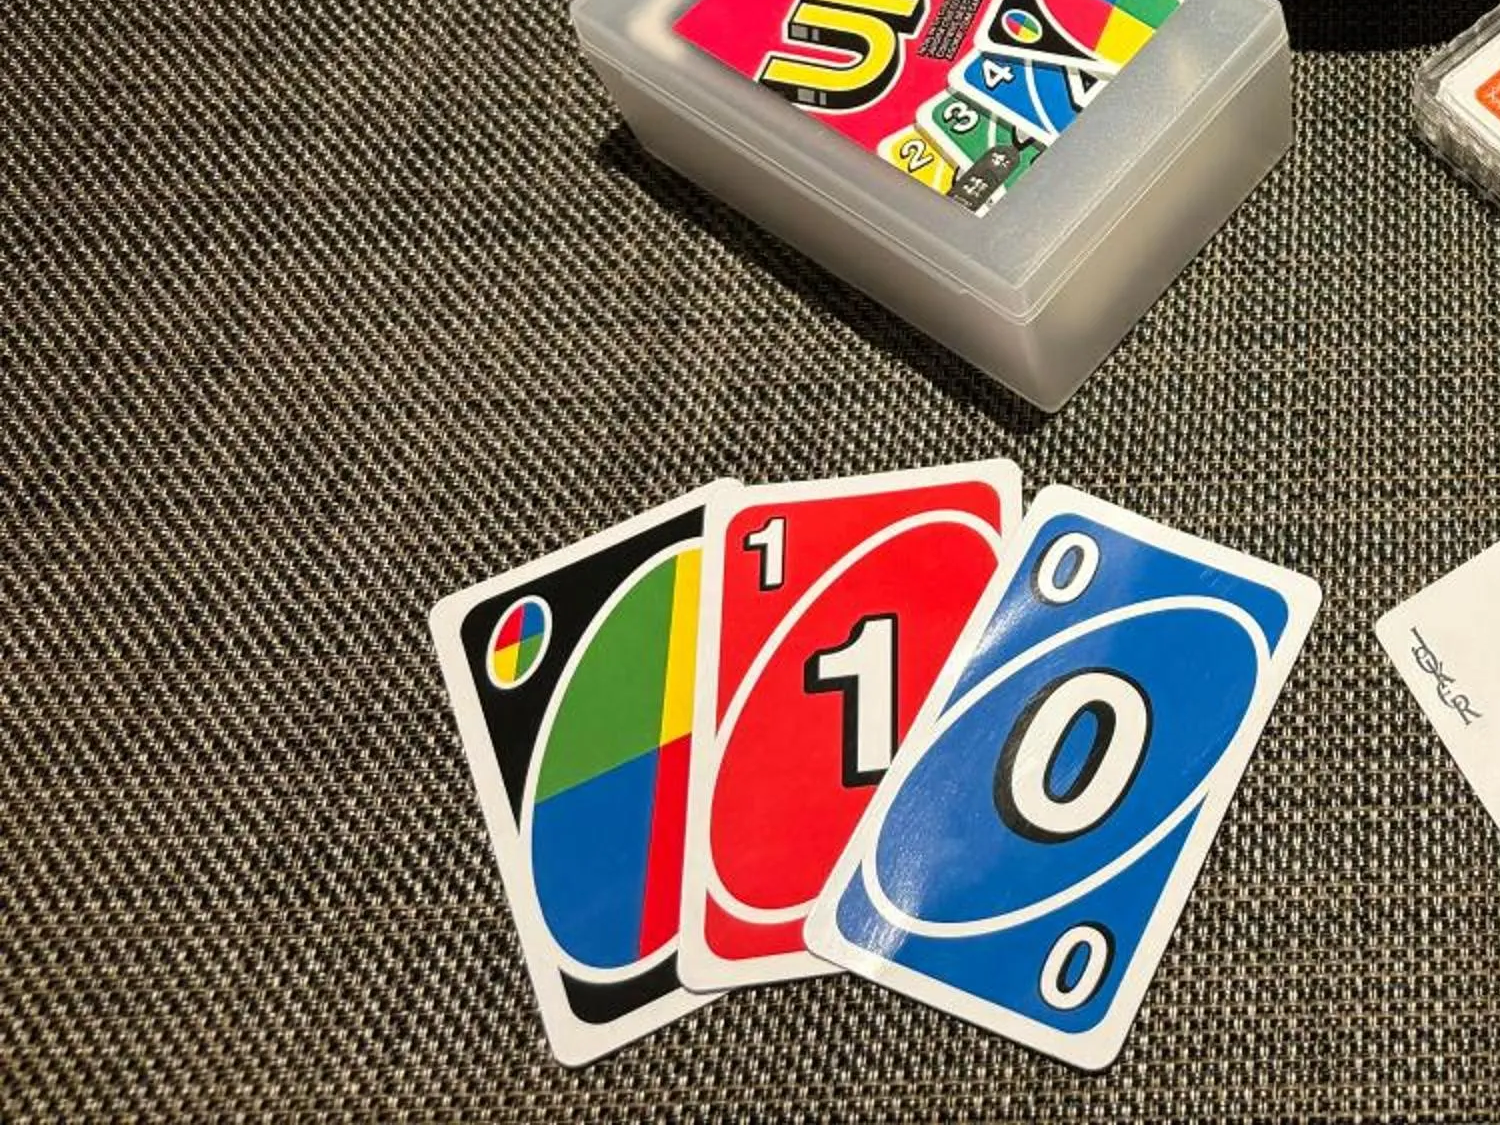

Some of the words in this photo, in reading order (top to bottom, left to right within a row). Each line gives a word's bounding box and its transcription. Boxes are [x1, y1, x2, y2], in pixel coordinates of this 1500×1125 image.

[981, 58, 1015, 90] 4
[942, 100, 979, 134] 3
[899, 138, 935, 172] 2
[743, 517, 788, 591] 1
[1029, 531, 1101, 608] 0
[803, 612, 900, 787] 1
[993, 666, 1153, 844] 0
[1037, 921, 1116, 1011] 0
